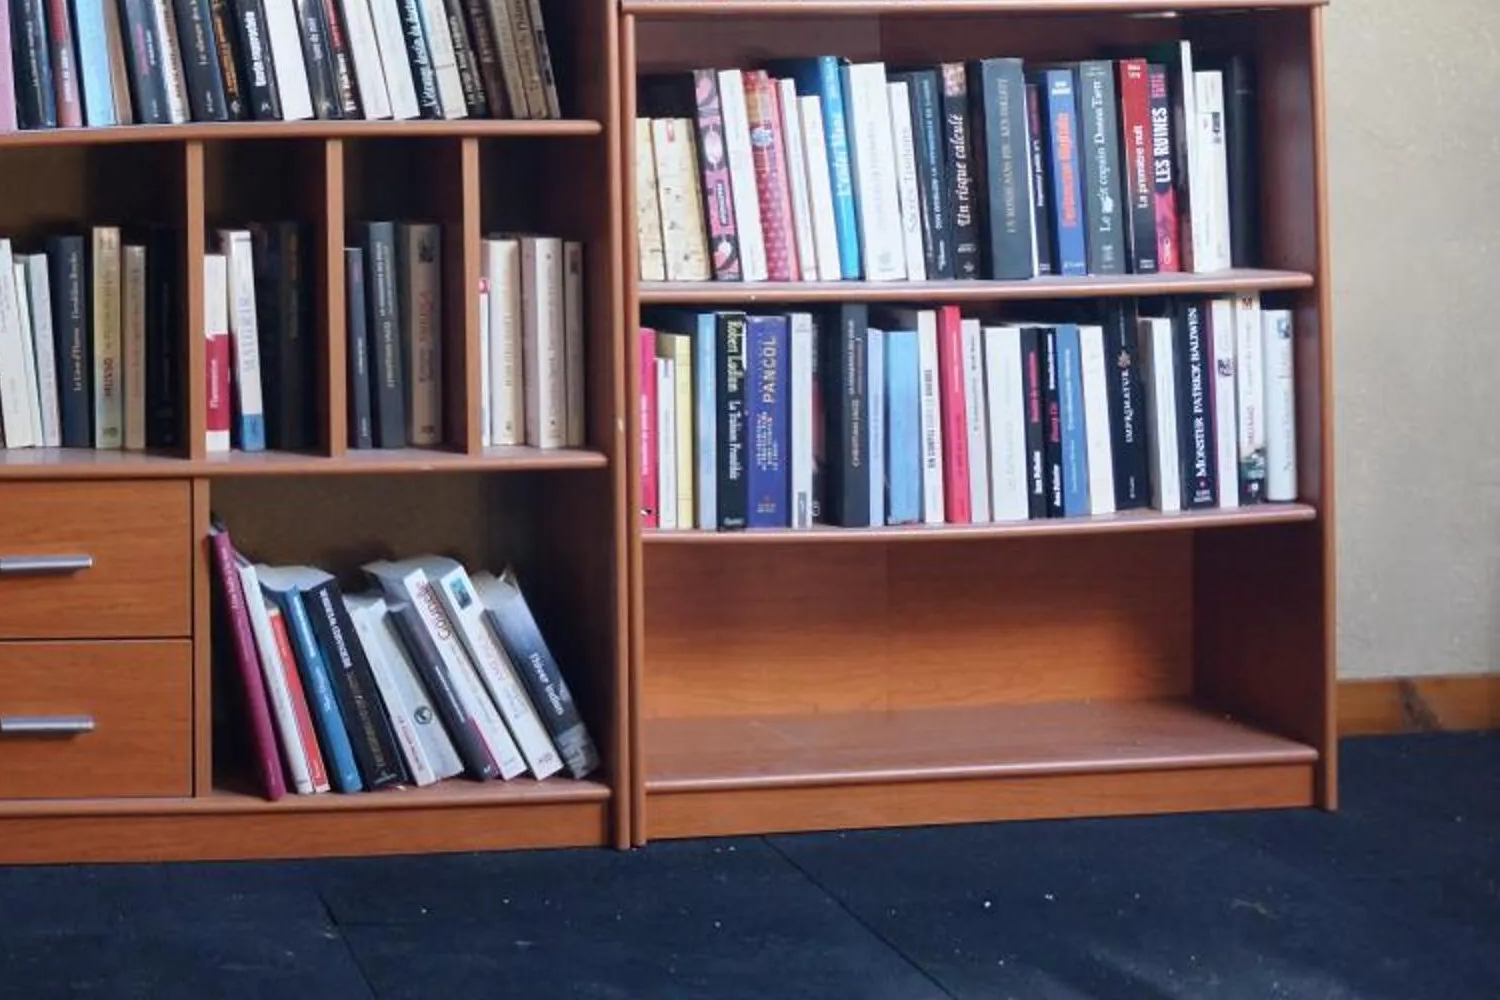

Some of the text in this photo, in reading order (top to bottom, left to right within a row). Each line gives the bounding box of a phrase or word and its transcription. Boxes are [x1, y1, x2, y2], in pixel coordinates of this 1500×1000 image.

[1151, 107, 1171, 183] LES RUINES
[955, 163, 974, 201] risque
[762, 336, 777, 404] PANCOL
[1190, 363, 1204, 414] PATRICK
[1193, 416, 1207, 478] MONSTER
